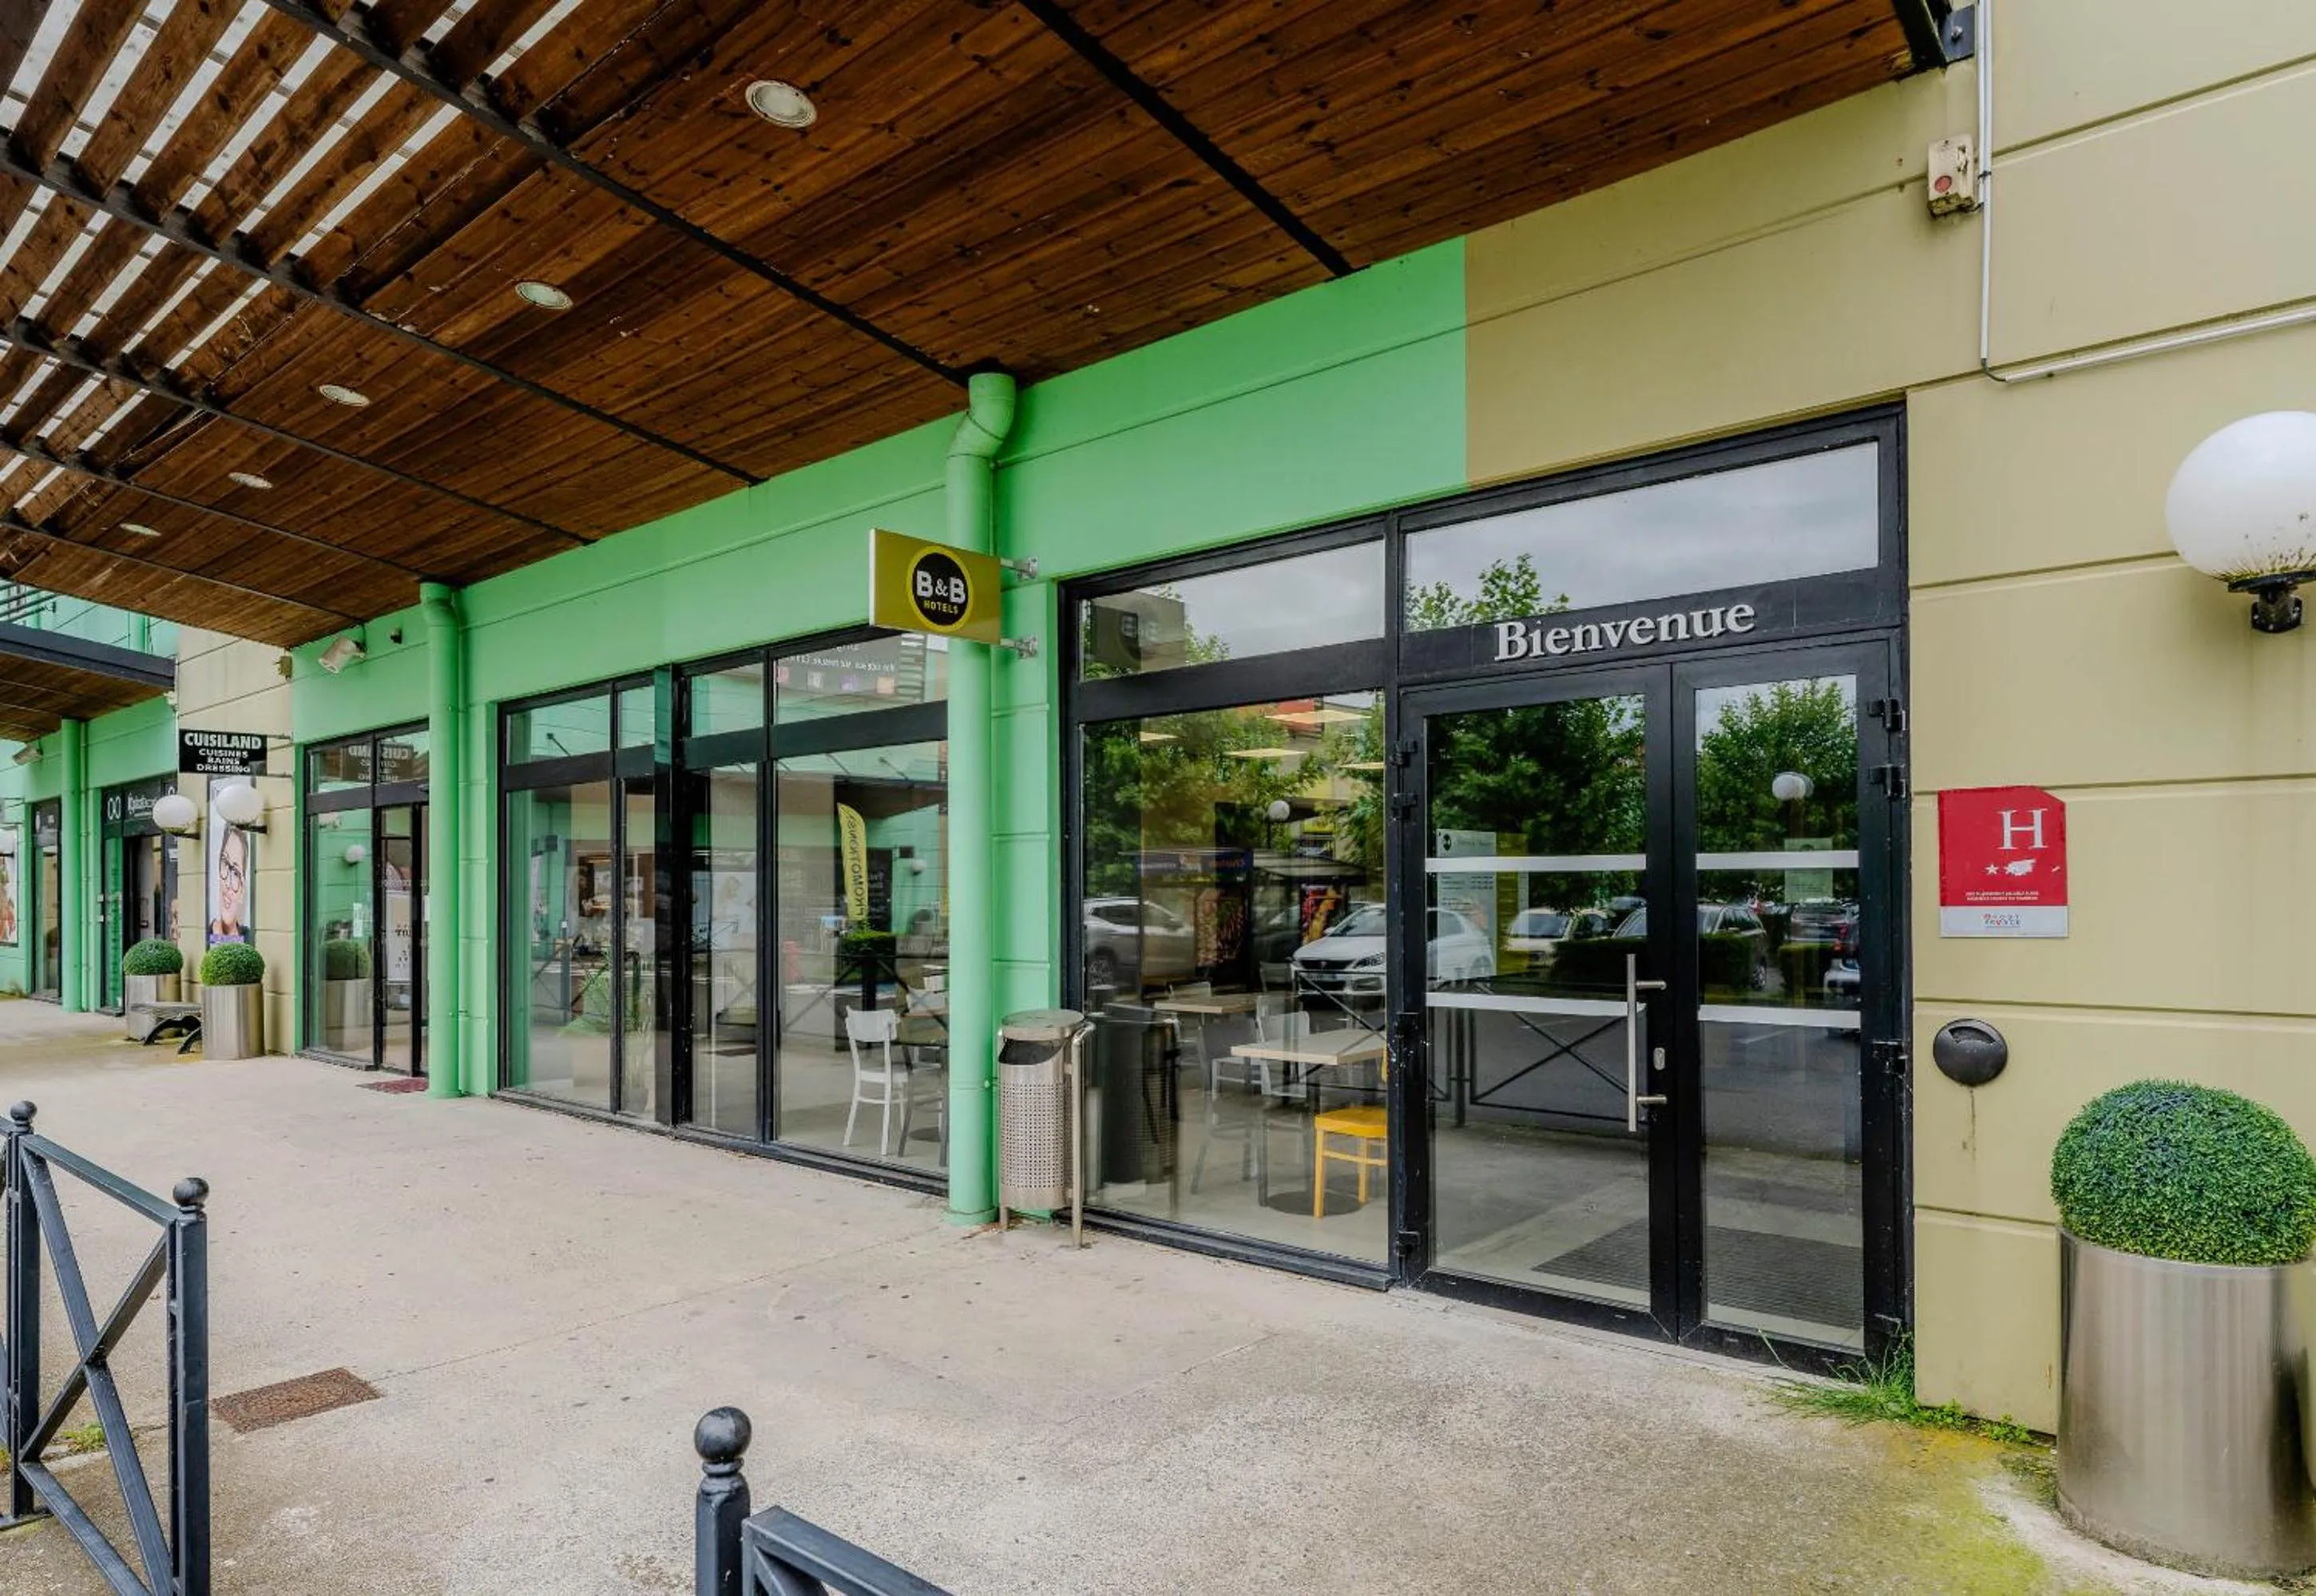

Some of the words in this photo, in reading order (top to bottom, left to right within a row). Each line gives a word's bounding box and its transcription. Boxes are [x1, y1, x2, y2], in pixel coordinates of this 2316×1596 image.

[916, 570, 966, 604] B&B
[923, 600, 959, 615] HOTELS
[1494, 602, 1755, 661] Bienvenue
[184, 732, 262, 749] CUISILAND
[198, 748, 248, 758] CUISINES
[207, 756, 240, 765] BAINS
[1997, 807, 2048, 849] H
